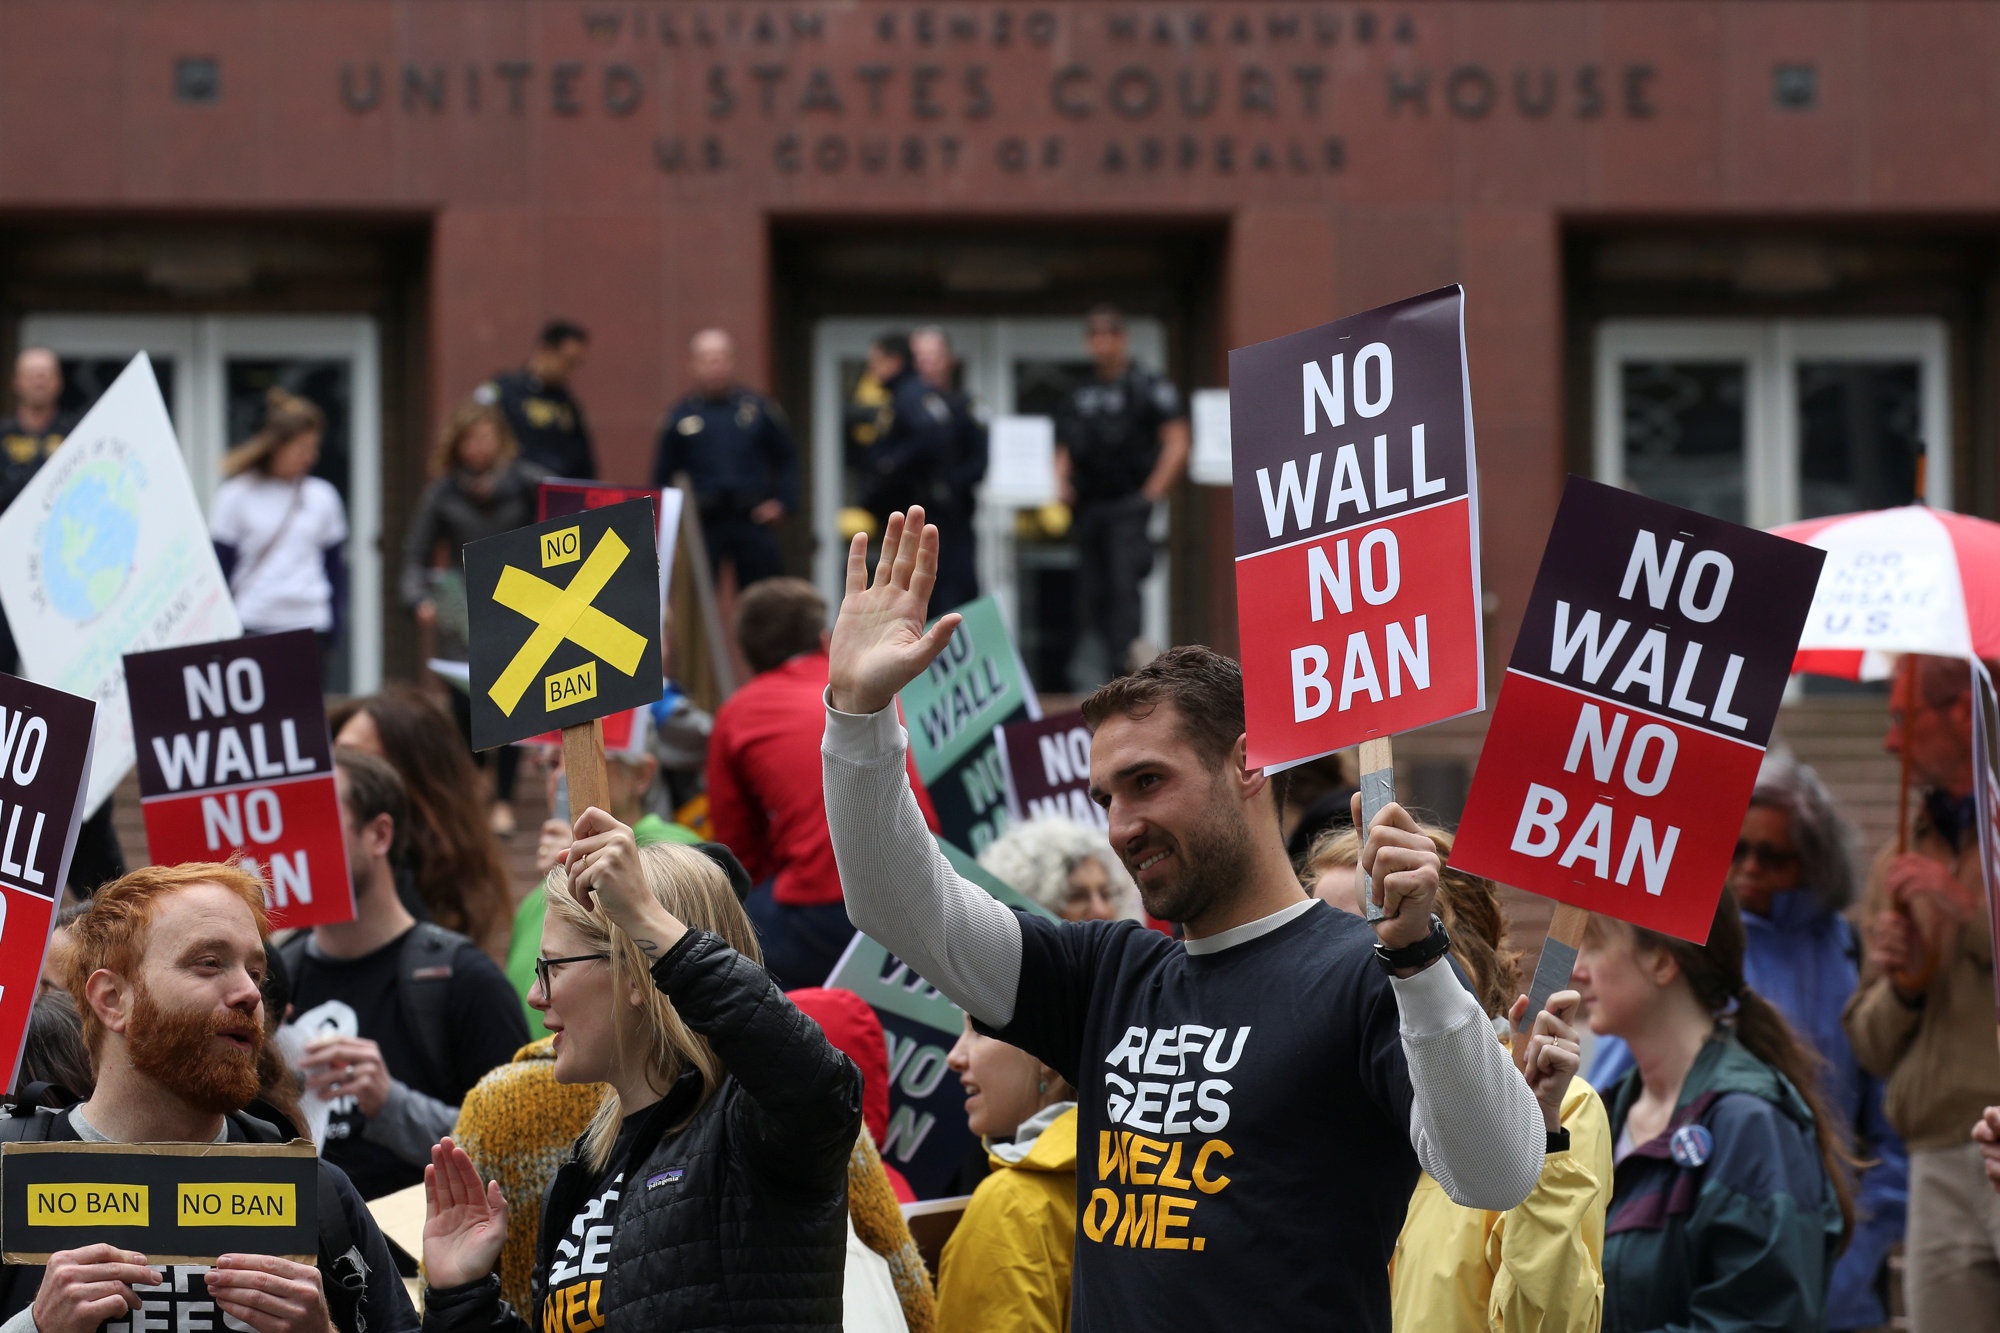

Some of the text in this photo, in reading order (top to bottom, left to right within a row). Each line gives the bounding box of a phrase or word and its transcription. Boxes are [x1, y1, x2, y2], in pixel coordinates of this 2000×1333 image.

[583, 9, 823, 46] WILLIAM
[337, 61, 1658, 121] UNITED STATES COURT HOUSE
[773, 135, 961, 173] COURT
[997, 136, 1060, 171] OF
[1104, 136, 1347, 174] APPEALS
[1302, 342, 1394, 435] NO
[1256, 423, 1446, 538] WALL
[546, 533, 577, 560] NO
[1307, 528, 1400, 622] NO
[1618, 528, 1734, 623] NO
[182, 657, 265, 721] NO
[550, 671, 591, 703] BAN
[1290, 614, 1431, 724] BAN
[1550, 600, 1748, 731] WALL
[920, 655, 1006, 755] WALL
[152, 718, 316, 790] WALL
[1038, 726, 1093, 787] NO
[1563, 702, 1678, 797] NO
[201, 788, 284, 851] NO
[1510, 782, 1681, 896] BAN
[1104, 1024, 1251, 1076] REFU
[1104, 1072, 1234, 1135] GEES
[1097, 1130, 1235, 1195] WELC
[38, 1192, 140, 1214] NO BAN
[182, 1194, 283, 1216] NO BAN
[1082, 1187, 1206, 1252] OME.
[543, 1279, 605, 1333] WEL
